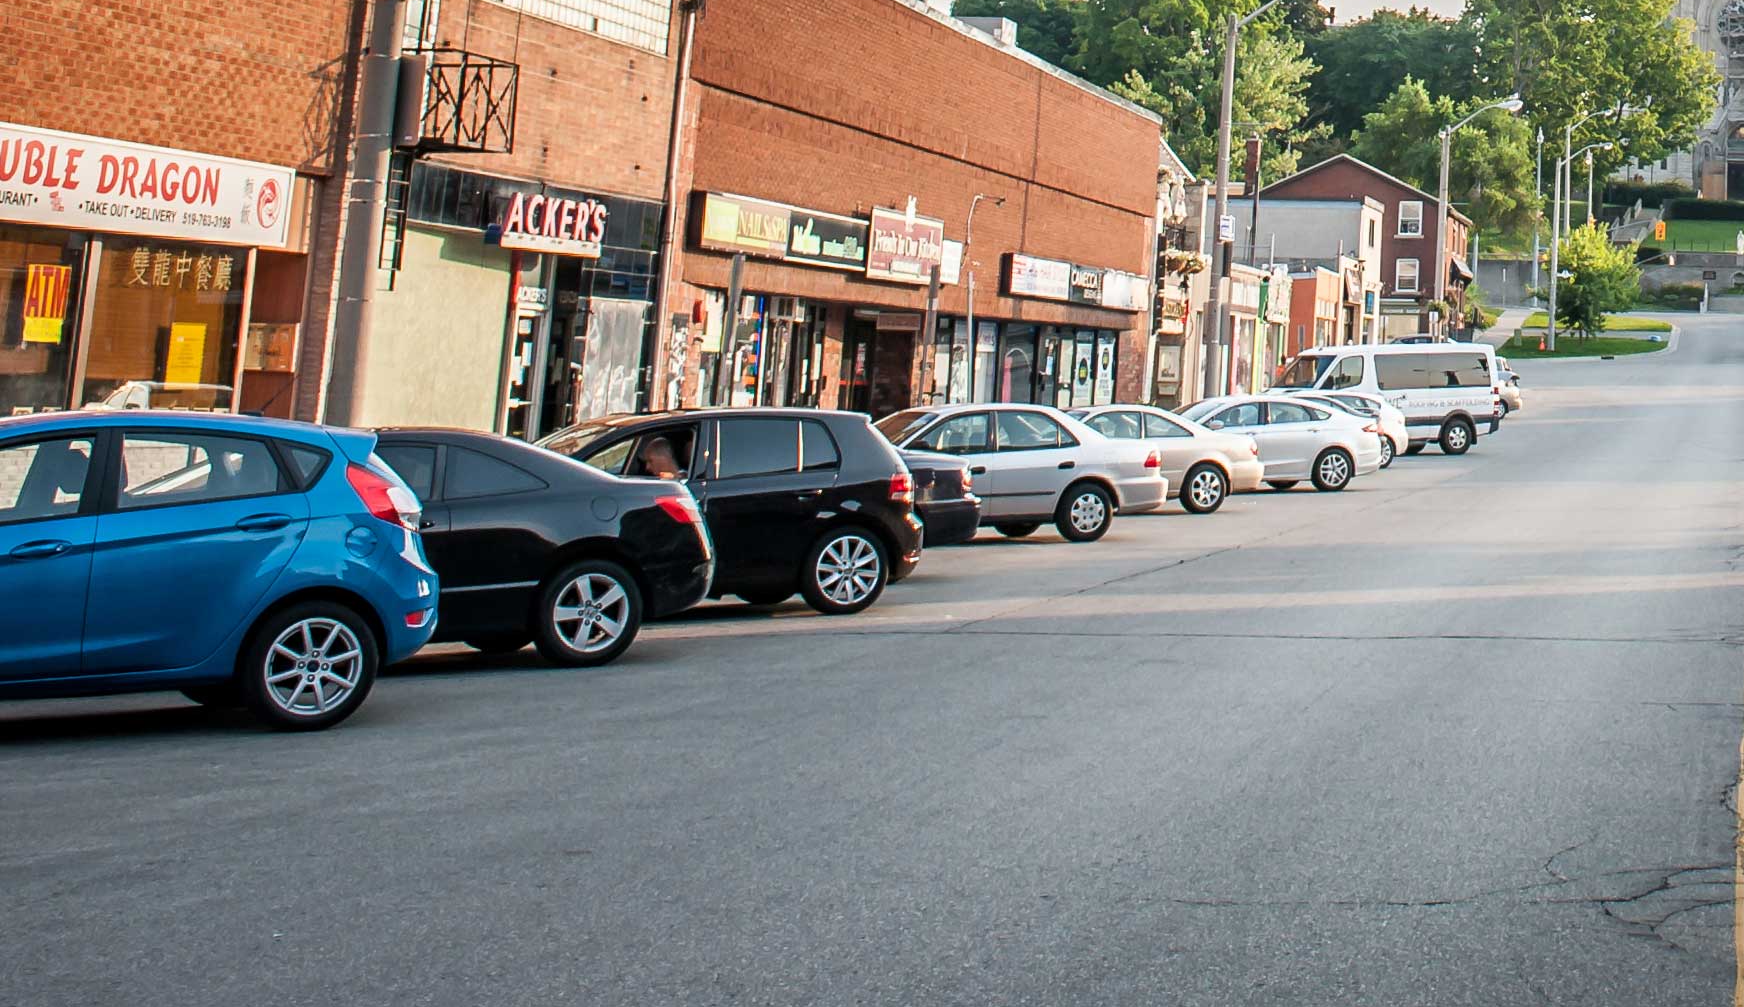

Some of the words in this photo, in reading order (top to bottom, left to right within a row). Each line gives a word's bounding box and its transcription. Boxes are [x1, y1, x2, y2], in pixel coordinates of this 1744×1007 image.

[96, 154, 221, 207] DRAGON
[85, 200, 107, 216] TAKE
[110, 204, 128, 218] OUT
[135, 206, 176, 224] DELIVERY
[502, 191, 608, 243] ACKER'S
[26, 265, 72, 317] ATM
